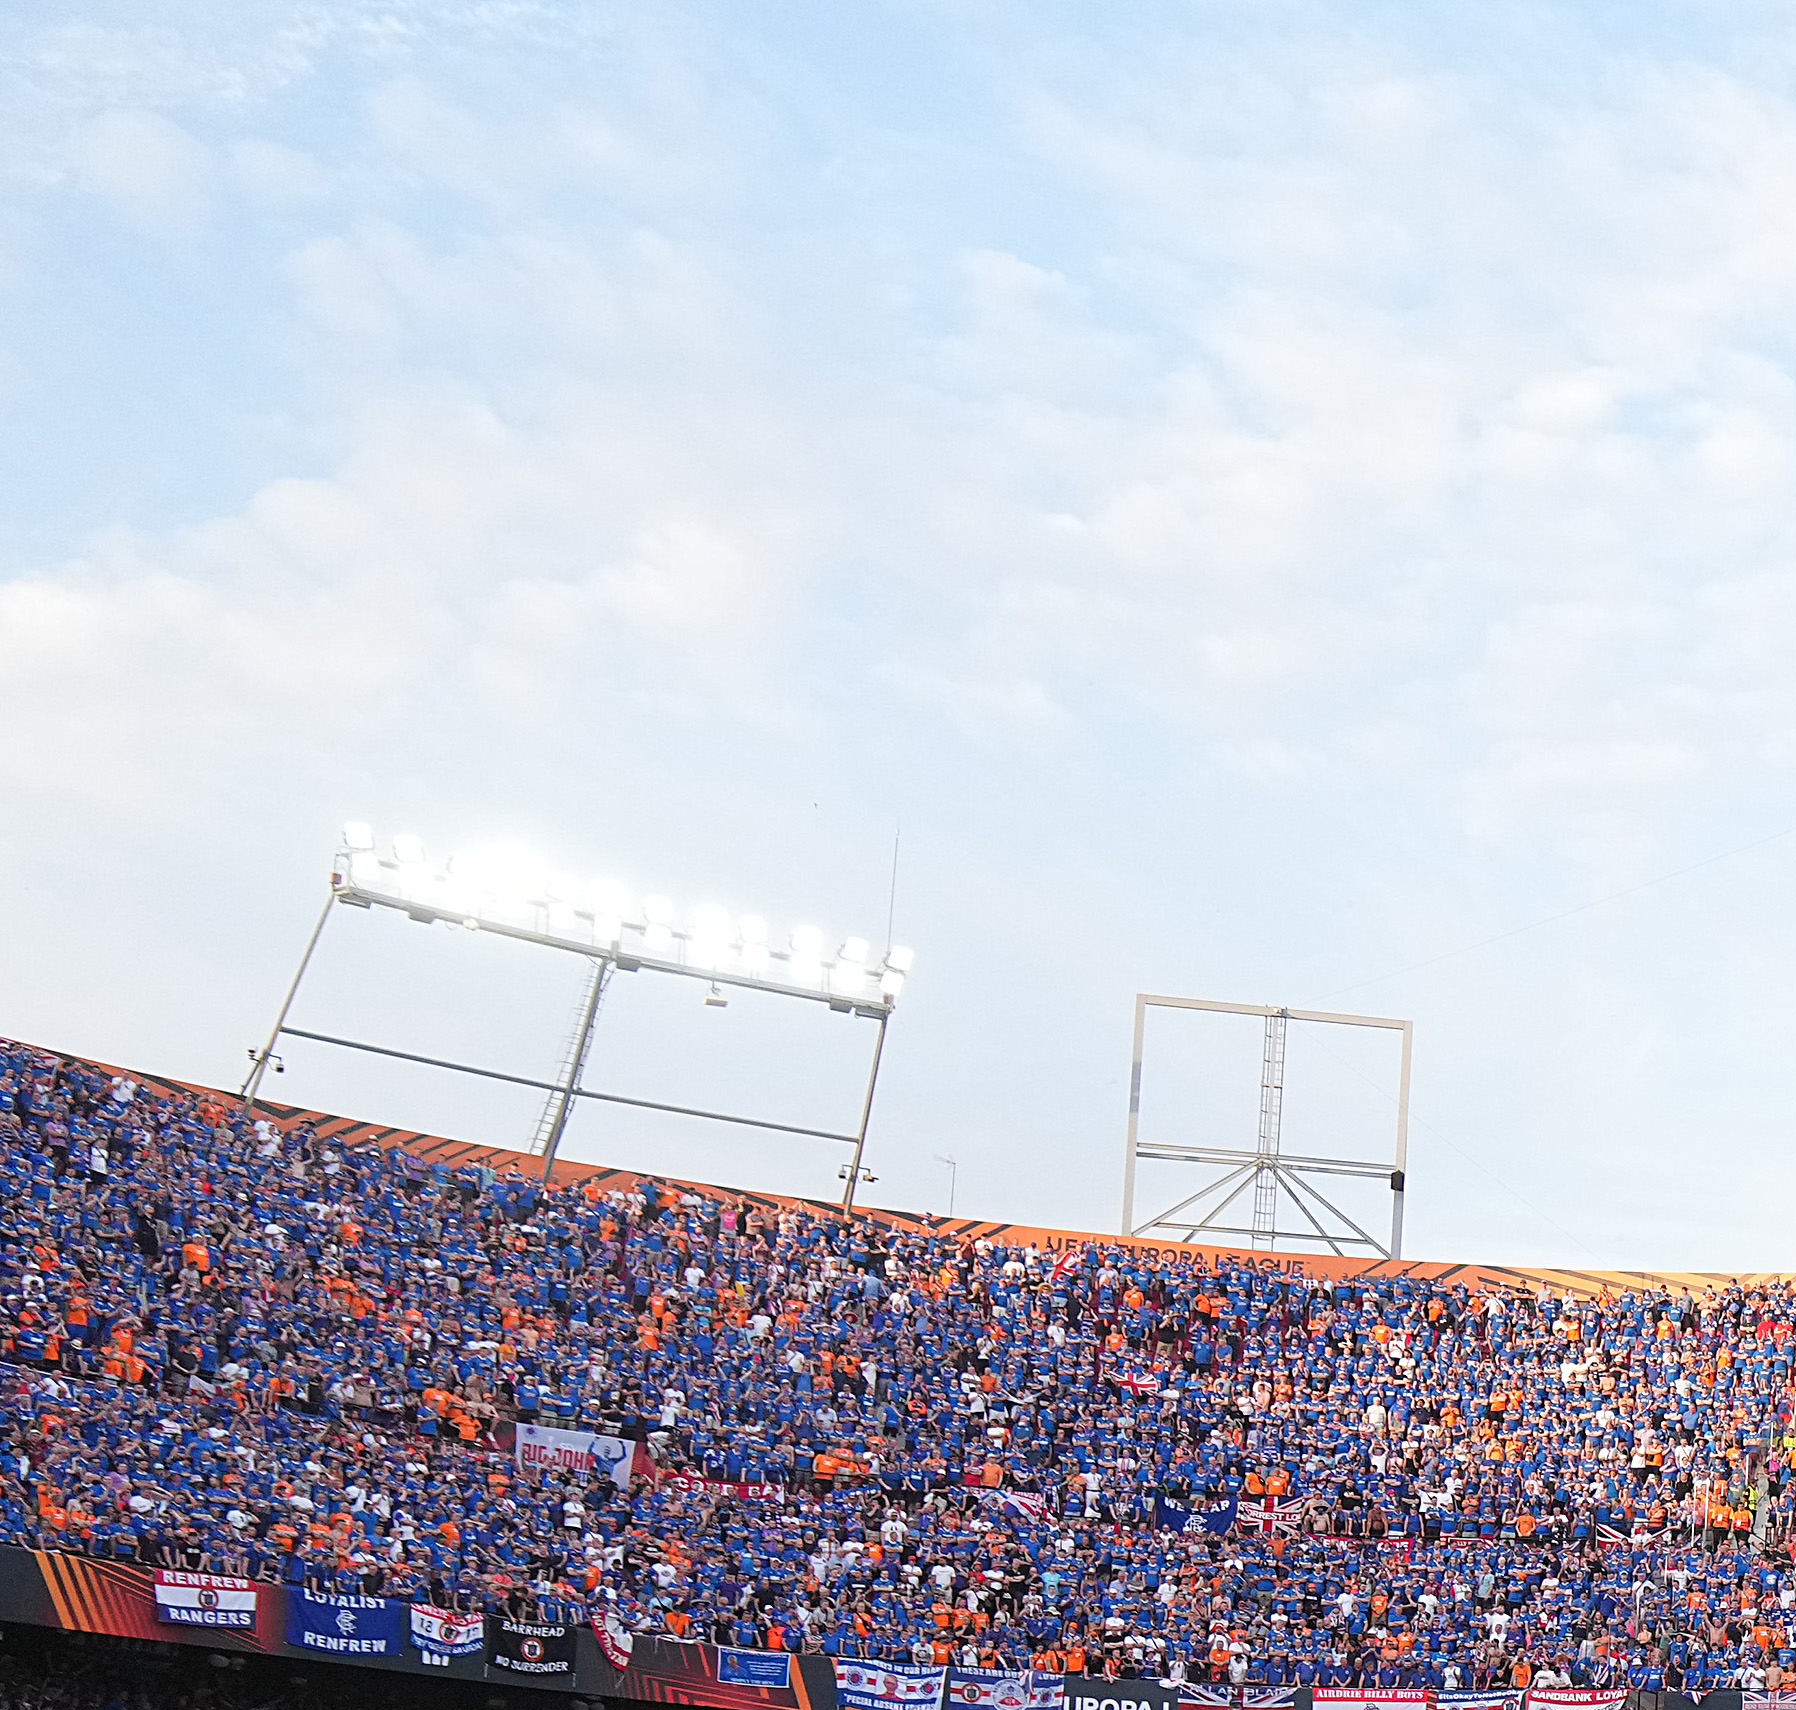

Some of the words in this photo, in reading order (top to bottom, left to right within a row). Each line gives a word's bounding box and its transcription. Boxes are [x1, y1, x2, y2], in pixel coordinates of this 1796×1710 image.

[1117, 1243, 1204, 1268] EUROPA
[1215, 1254, 1304, 1276] LEAGUE
[163, 1570, 249, 1589] RENFREW
[169, 1607, 251, 1626] RANGERS
[502, 1620, 565, 1638] BARRHEAD
[303, 1631, 386, 1653] RENFREW
[495, 1654, 510, 1669] NO
[511, 1658, 569, 1673] SURRENDER
[1316, 1690, 1360, 1698] AIRDRIE
[1361, 1690, 1394, 1698] BILLY
[1396, 1691, 1423, 1699] BOYS
[1531, 1690, 1593, 1702] SANDBANK
